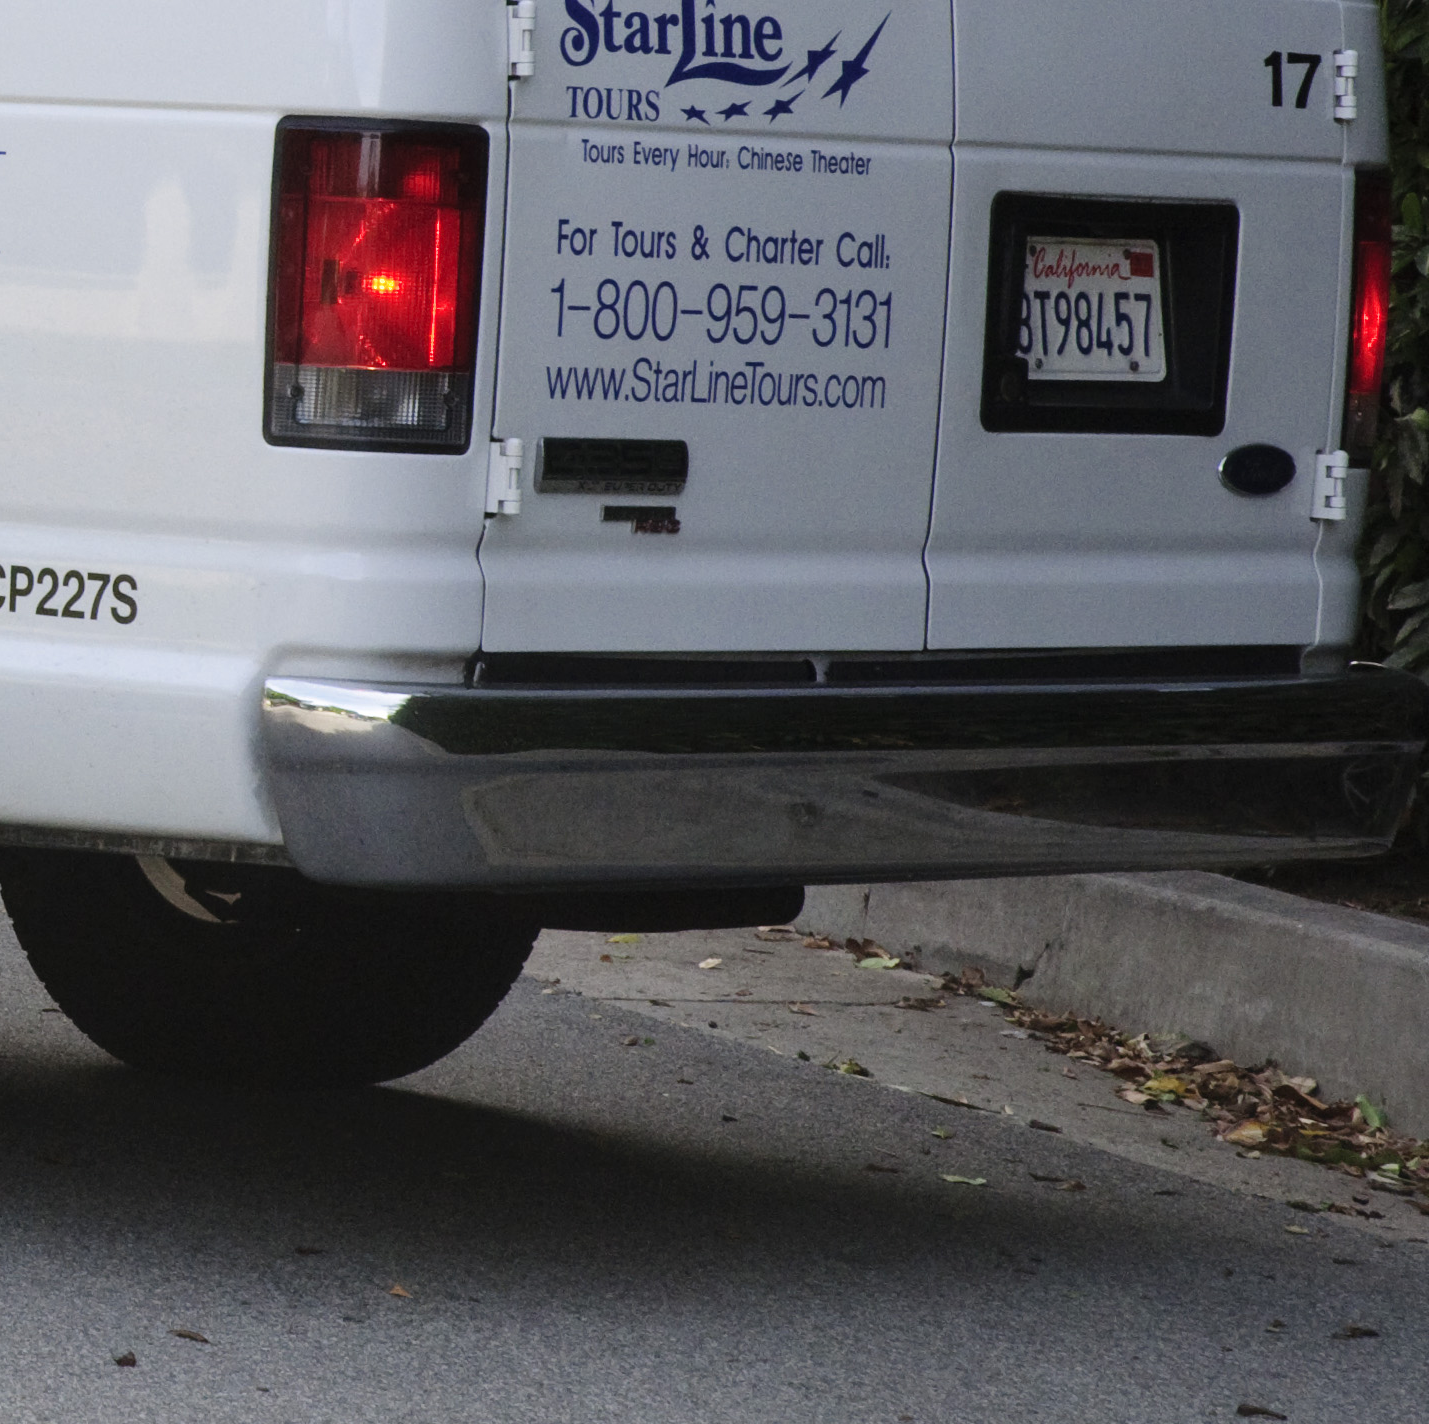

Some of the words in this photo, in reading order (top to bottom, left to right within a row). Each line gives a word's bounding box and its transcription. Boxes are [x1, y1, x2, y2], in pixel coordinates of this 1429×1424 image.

[566, 86, 661, 122] TOURS
[1263, 50, 1323, 109] 17
[581, 138, 625, 164] Tours
[633, 141, 680, 171] Every
[738, 146, 803, 173] Chinese
[811, 149, 872, 175] Theater
[557, 219, 598, 256] For
[611, 221, 677, 260] Tours
[690, 225, 711, 261] &
[725, 226, 824, 265] Charter
[836, 232, 891, 269] Call:
[1033, 247, 1131, 289] California
[551, 278, 893, 349] 1-800-959-3131
[546, 357, 886, 409] www.StarLineTours.com
